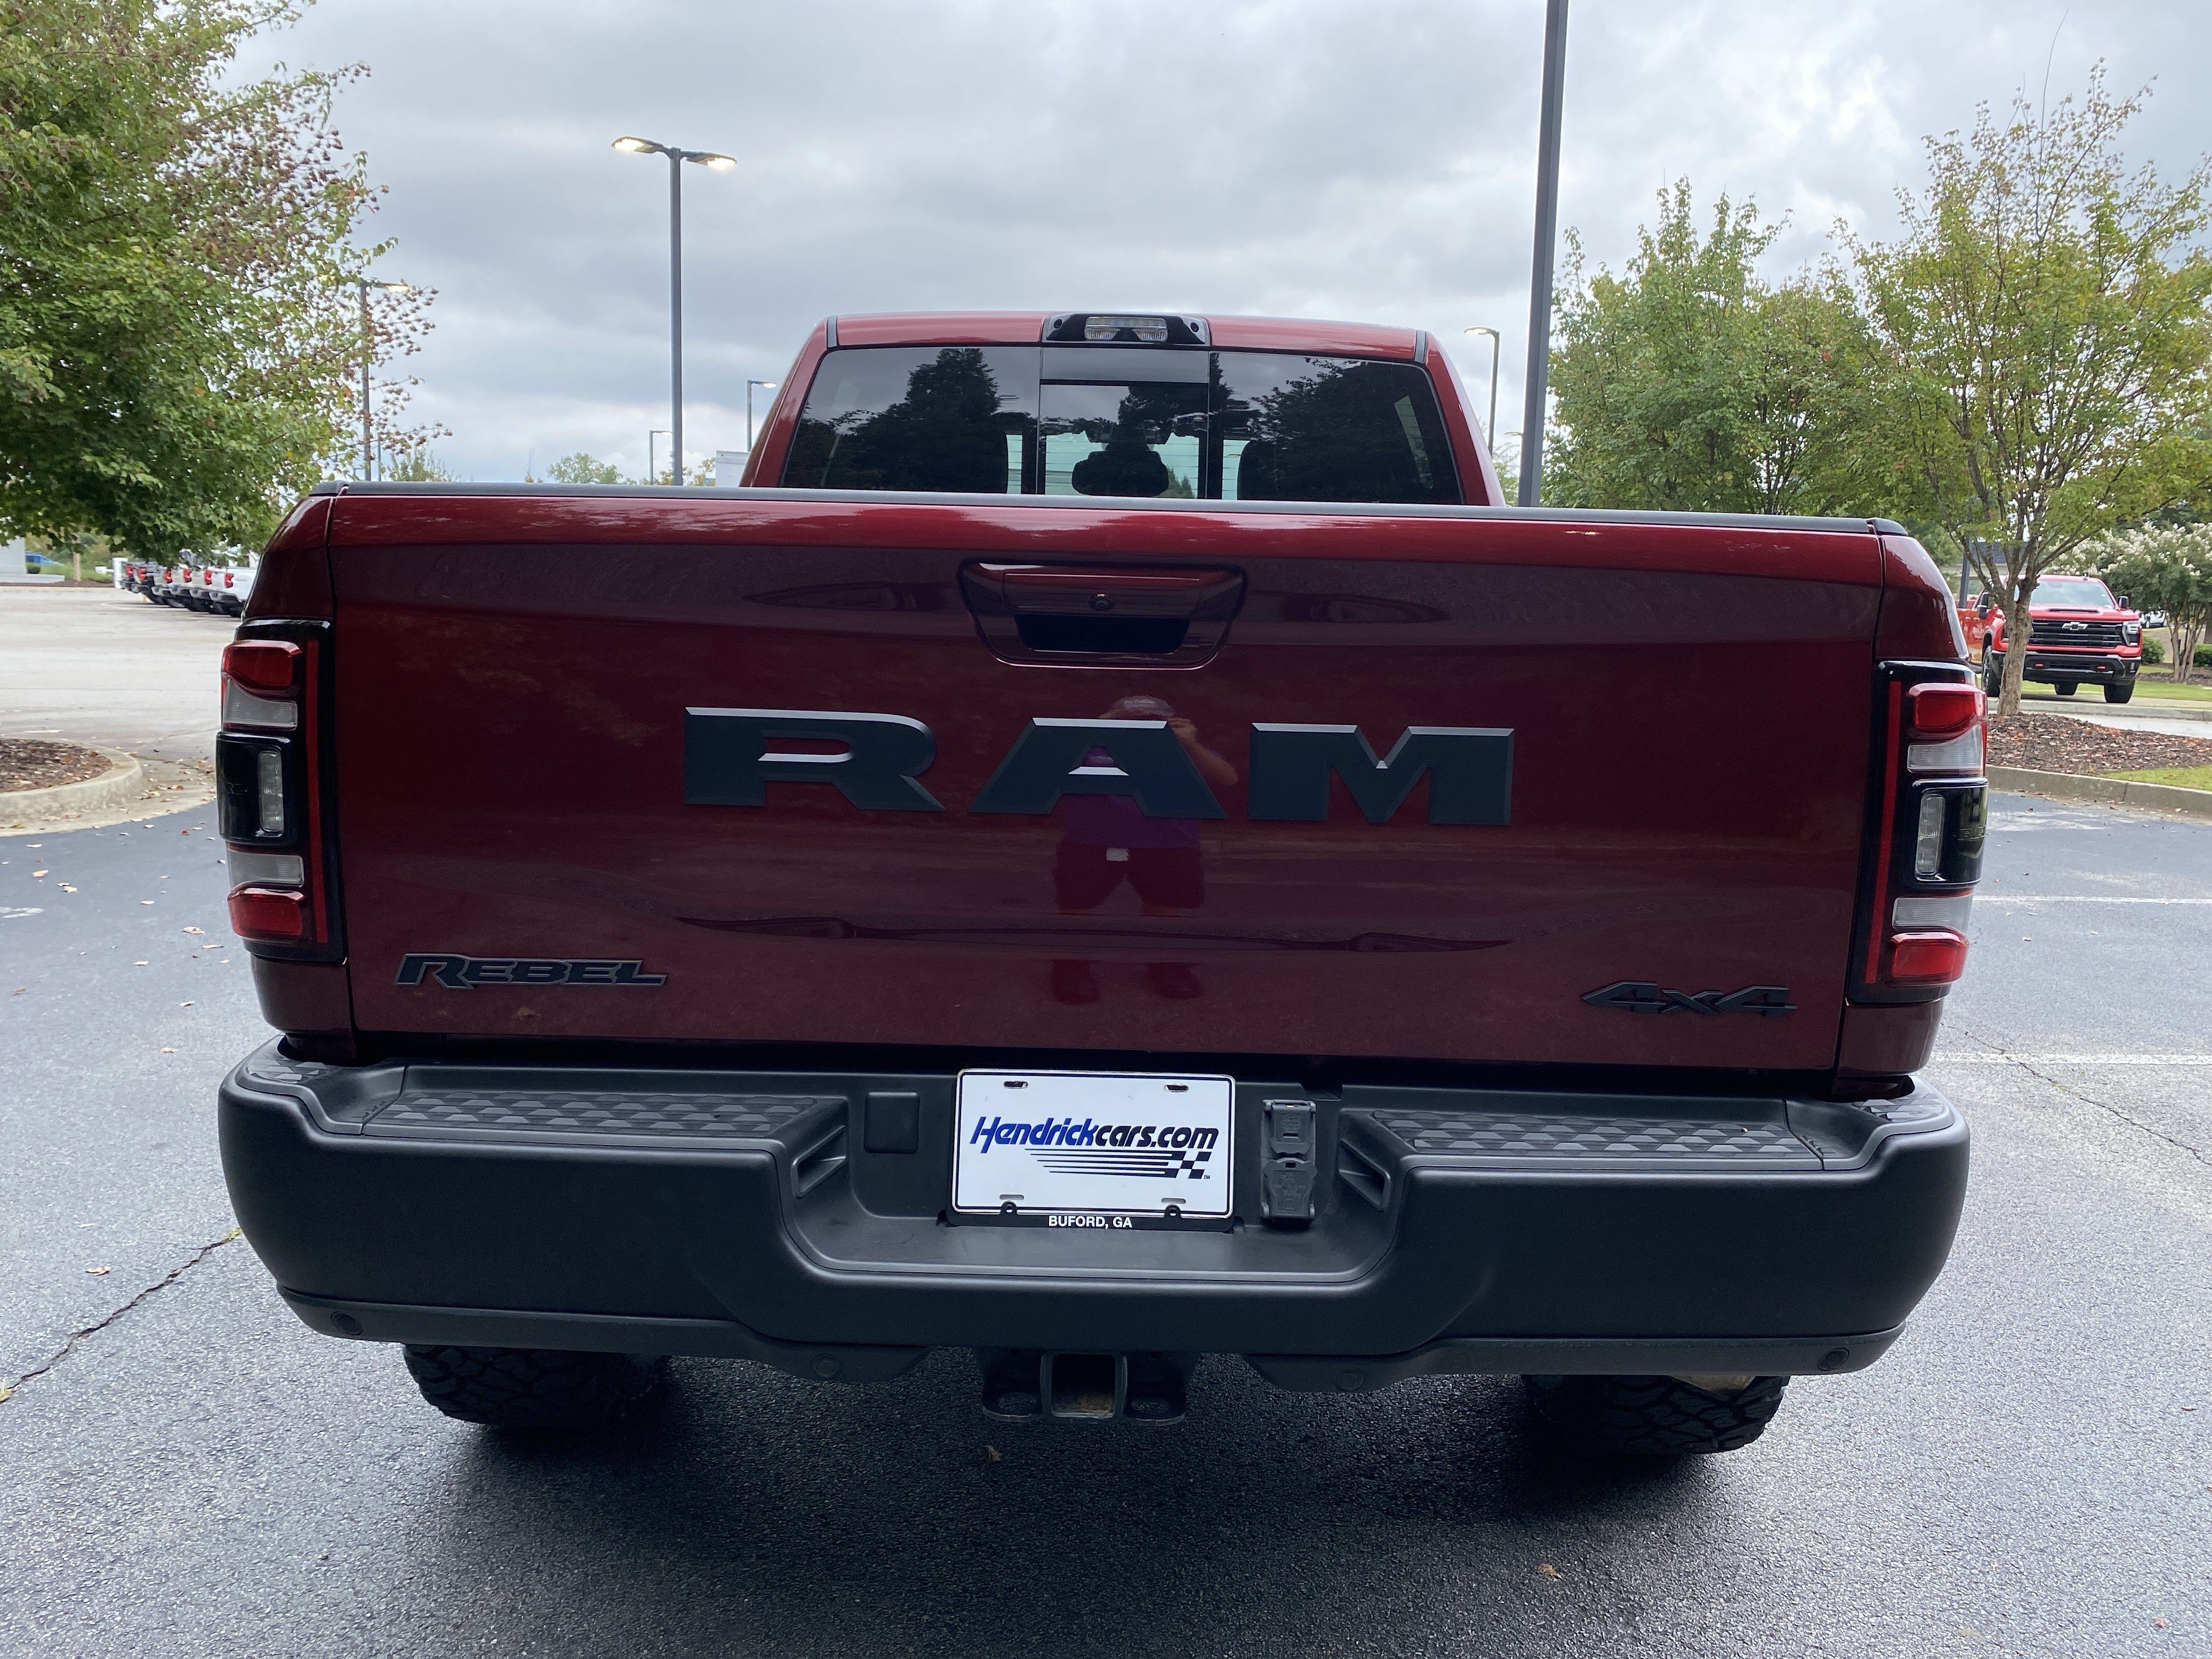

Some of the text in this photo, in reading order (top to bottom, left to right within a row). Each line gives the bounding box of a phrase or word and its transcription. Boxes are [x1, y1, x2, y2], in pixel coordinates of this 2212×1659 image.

[684, 707, 1515, 826] RAM
[393, 952, 668, 989] REBEL
[969, 1116, 1220, 1154] Hendrickcars.com
[1048, 1215, 1132, 1229] BUFORD, GA
